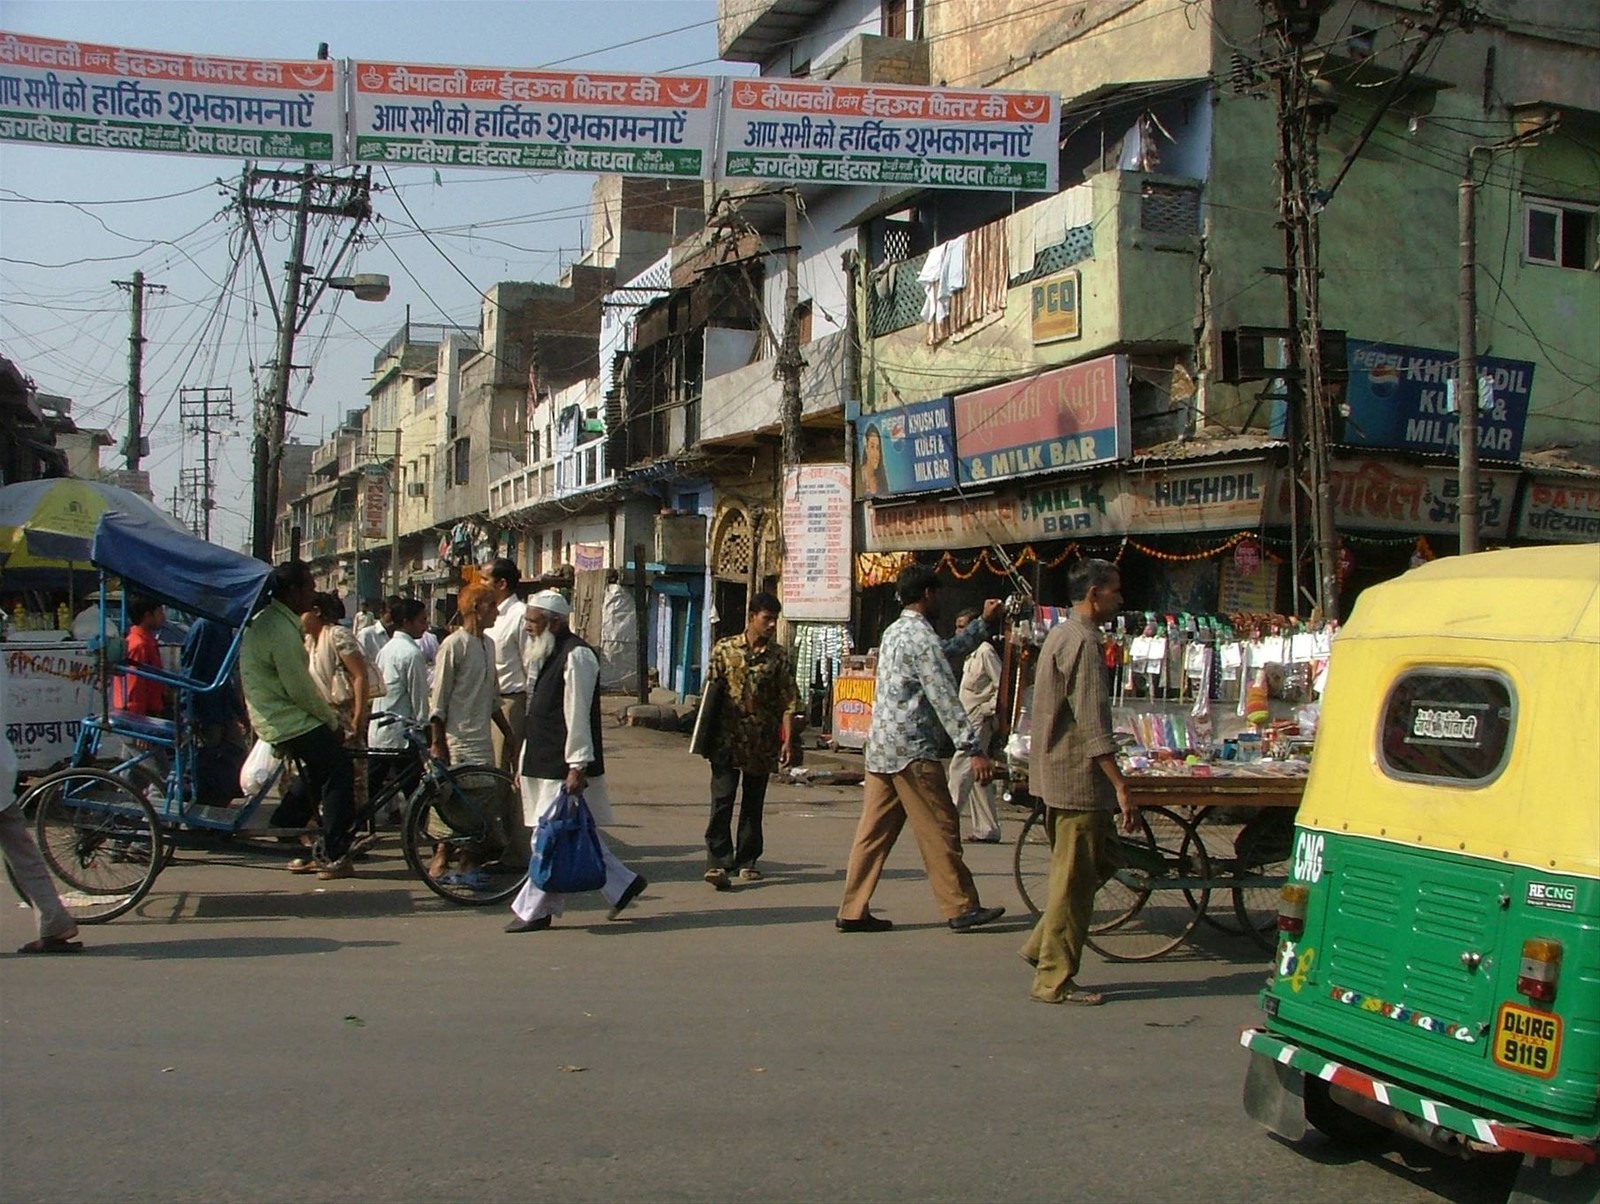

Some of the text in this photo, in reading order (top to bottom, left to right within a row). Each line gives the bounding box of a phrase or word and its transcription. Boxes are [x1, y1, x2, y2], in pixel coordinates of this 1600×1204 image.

[0, 35, 81, 67] दीपावली
[190, 55, 247, 82] फितर
[252, 61, 283, 84] की
[24, 72, 60, 110] सभी
[63, 77, 87, 112] को
[92, 80, 162, 119] हार्दिक
[387, 66, 468, 95] दीपावली
[571, 76, 628, 101] फितर
[630, 77, 661, 102] की
[761, 88, 833, 111] दीपावली
[928, 94, 979, 118] फितर
[980, 95, 1007, 119] की
[0, 115, 144, 148] जगदीश टाईटलर
[372, 105, 407, 133] आप
[411, 100, 444, 134] सभी
[447, 104, 470, 136] को
[474, 105, 542, 140] हार्दिक
[744, 120, 777, 147] आप
[779, 116, 812, 148] सभी
[814, 119, 834, 150] को
[839, 119, 900, 151] हार्दिक
[186, 126, 214, 153] प्रेम
[215, 135, 262, 156] वधवा
[384, 140, 455, 163] जगदीश
[458, 142, 521, 166] टाईटलर
[562, 146, 589, 171] प्रेम
[591, 152, 636, 172] वधवा
[752, 154, 818, 179] जगदीश
[821, 155, 881, 181] टाईटलर
[918, 158, 943, 183] प्रेम
[945, 165, 986, 185] वधवा
[1032, 280, 1074, 322] PCO
[1352, 351, 1403, 369] PEPSI
[1493, 367, 1527, 394] DIL
[935, 408, 948, 429] DIL
[1492, 398, 1507, 422] &
[914, 434, 945, 457] KULFI &
[971, 436, 1097, 480] & MILK BAR
[914, 458, 950, 482] MILK BAR
[1032, 484, 1107, 519] MILK
[1044, 513, 1091, 533] BAR
[1294, 832, 1324, 883] CNG
[1504, 1039, 1548, 1069] 9119
